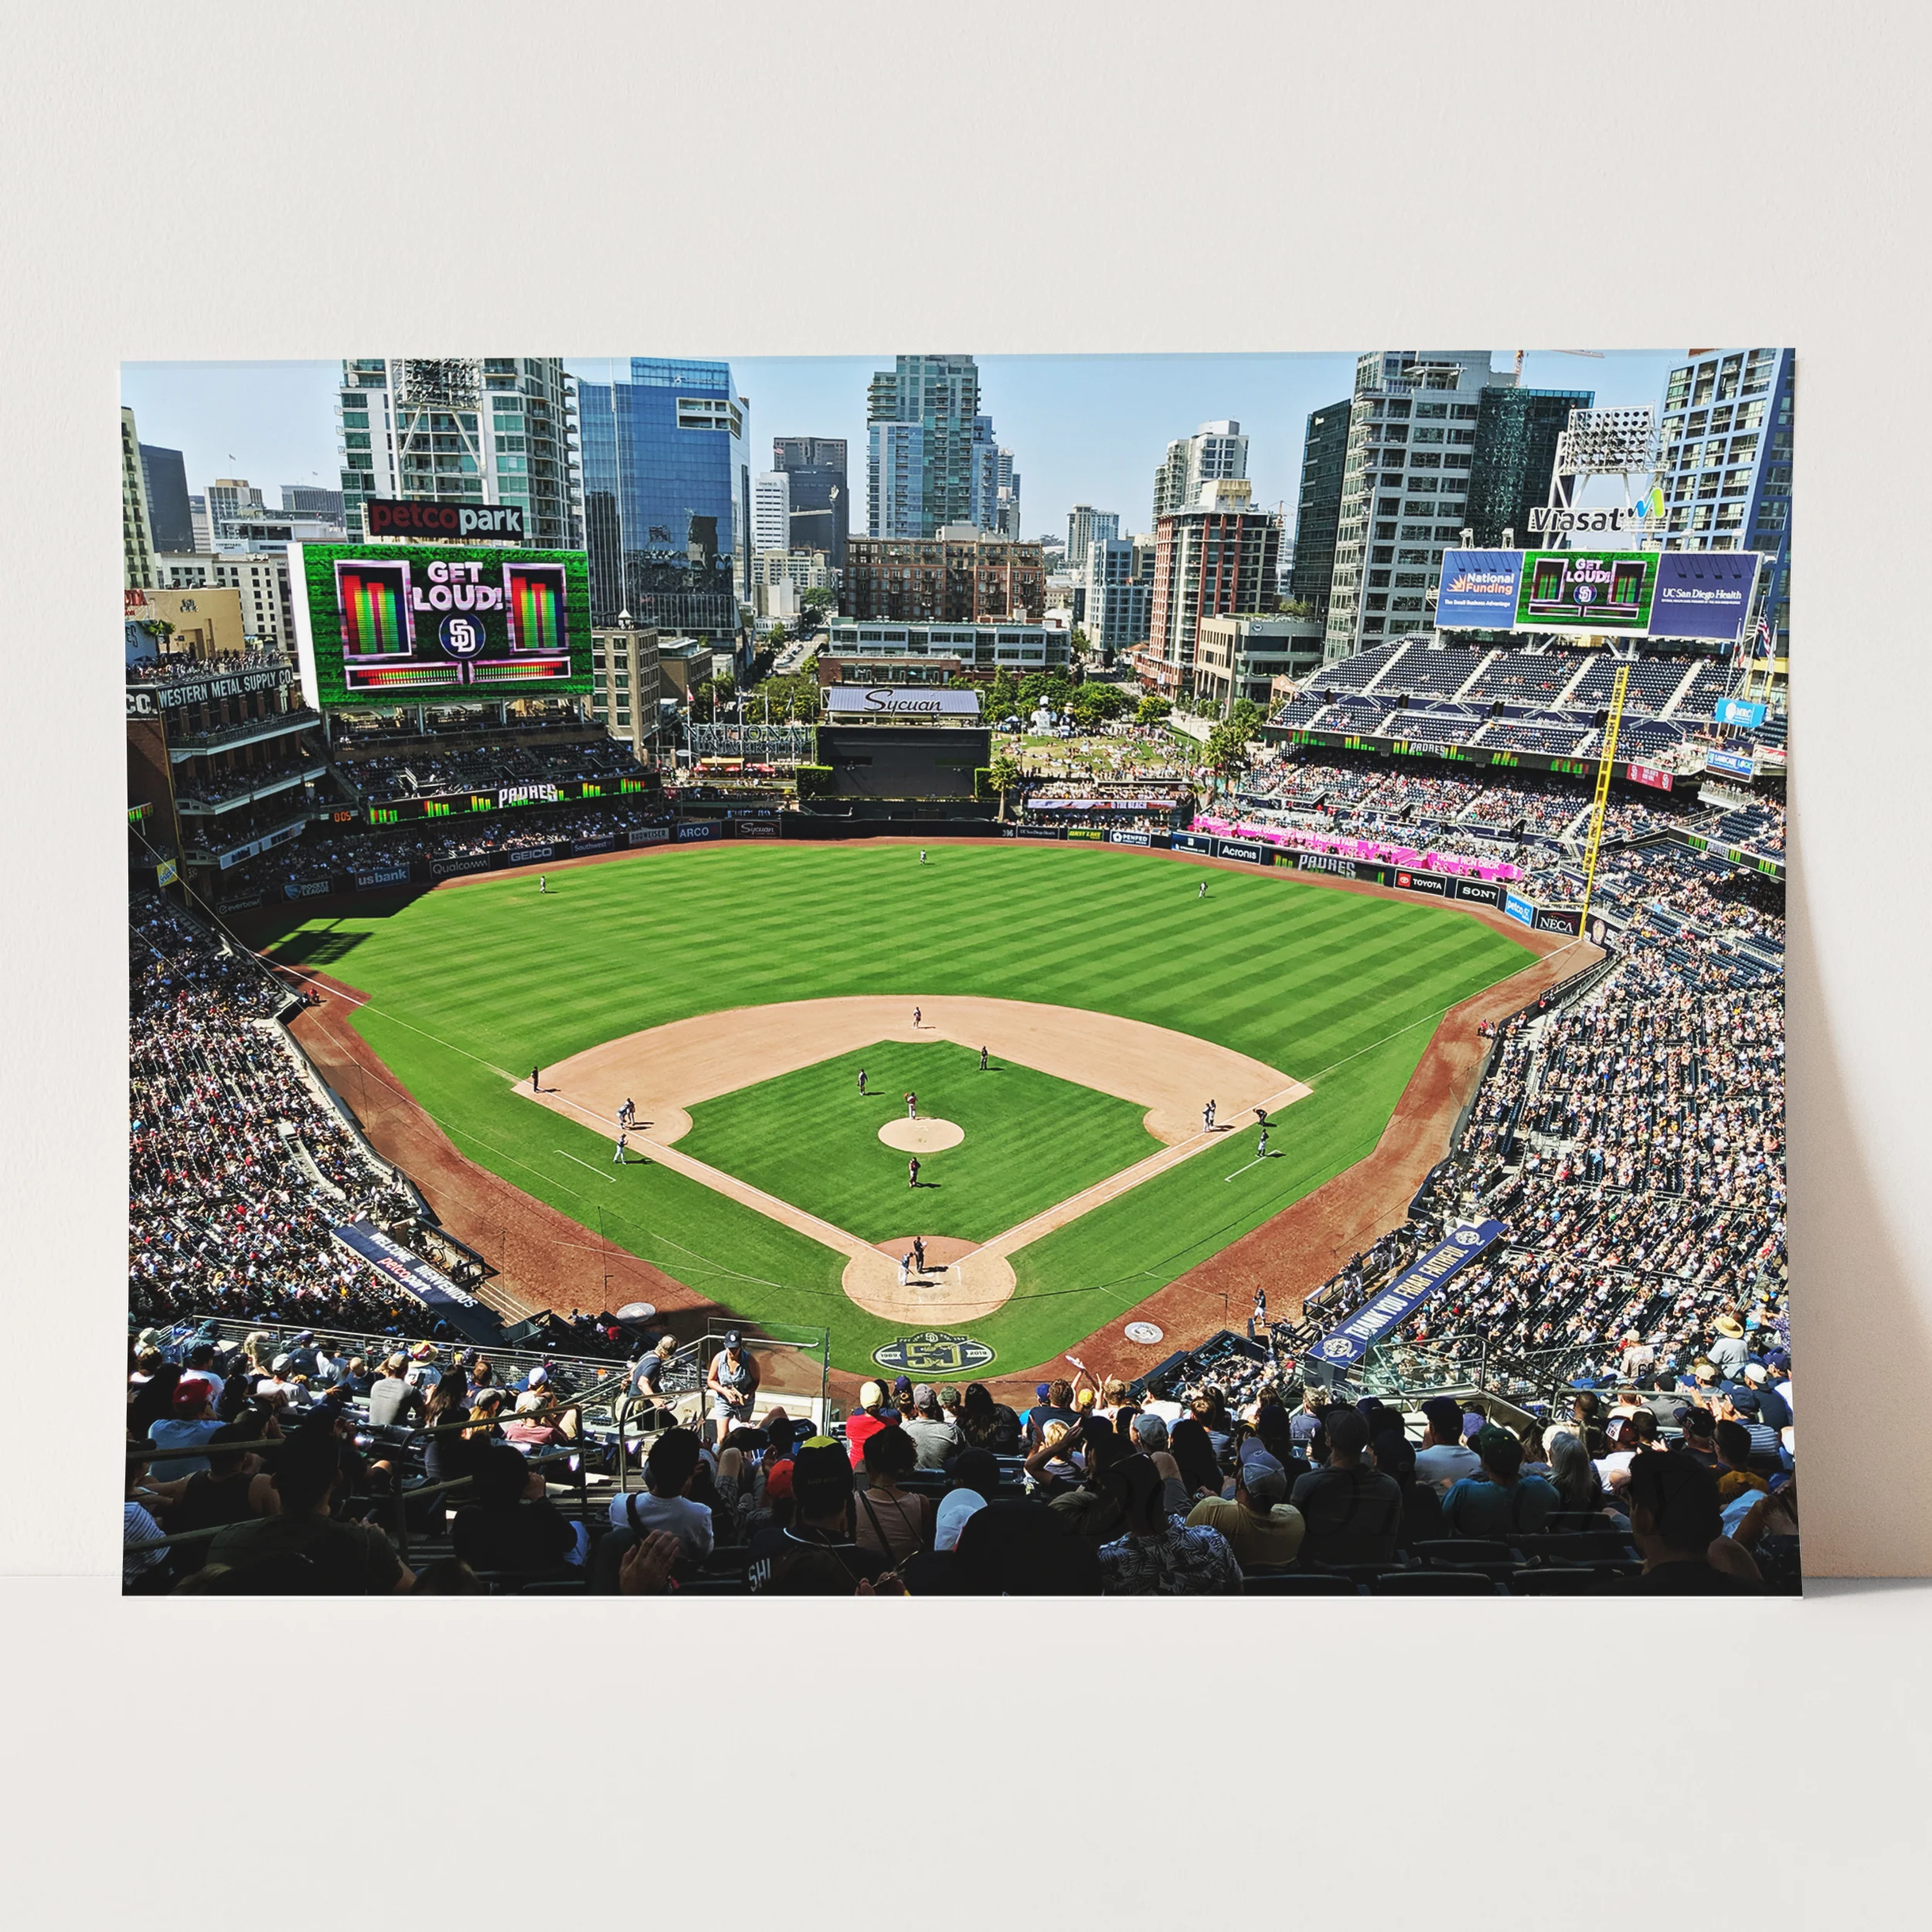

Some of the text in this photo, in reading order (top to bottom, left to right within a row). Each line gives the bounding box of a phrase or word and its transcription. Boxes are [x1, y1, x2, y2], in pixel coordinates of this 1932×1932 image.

[1533, 508, 1624, 531] Viasat
[1576, 559, 1604, 570] GET
[427, 561, 483, 583] GET
[1467, 573, 1514, 583] National
[1566, 570, 1612, 583] LOUD!
[1465, 583, 1513, 595] Funding
[1662, 588, 1742, 600] UC San Diego Health
[413, 584, 503, 611] LOUD!
[449, 619, 476, 652] SD
[158, 669, 294, 709] WESTERN METAL SUPPLY CO.
[863, 689, 944, 717] Sycuan
[682, 723, 816, 740] NATIONAL
[697, 740, 805, 754] UNIVERSITY
[1410, 742, 1445, 758] PADRES
[498, 783, 559, 808] PADRES
[631, 829, 667, 840] BUDWEISER
[679, 827, 709, 838] ARCO
[741, 822, 774, 835] Sycuan
[1122, 834, 1148, 842] PENFED
[574, 841, 607, 851] Southwest
[1222, 845, 1257, 859] Acronis
[511, 848, 553, 862] GEICO
[1437, 853, 1459, 864] HOME
[1479, 859, 1500, 871] DECK
[1298, 854, 1356, 879] PADRES
[1413, 878, 1442, 889] TOYOTA
[302, 886, 329, 896] LEAGUE
[1462, 886, 1497, 899] SONY
[1540, 917, 1573, 934] NECA
[369, 1232, 416, 1263] WELCOME
[414, 1264, 478, 1308] BIENVENIDOS
[1344, 1244, 1469, 1340] THANK YOU FRIAR FAITHFUL
